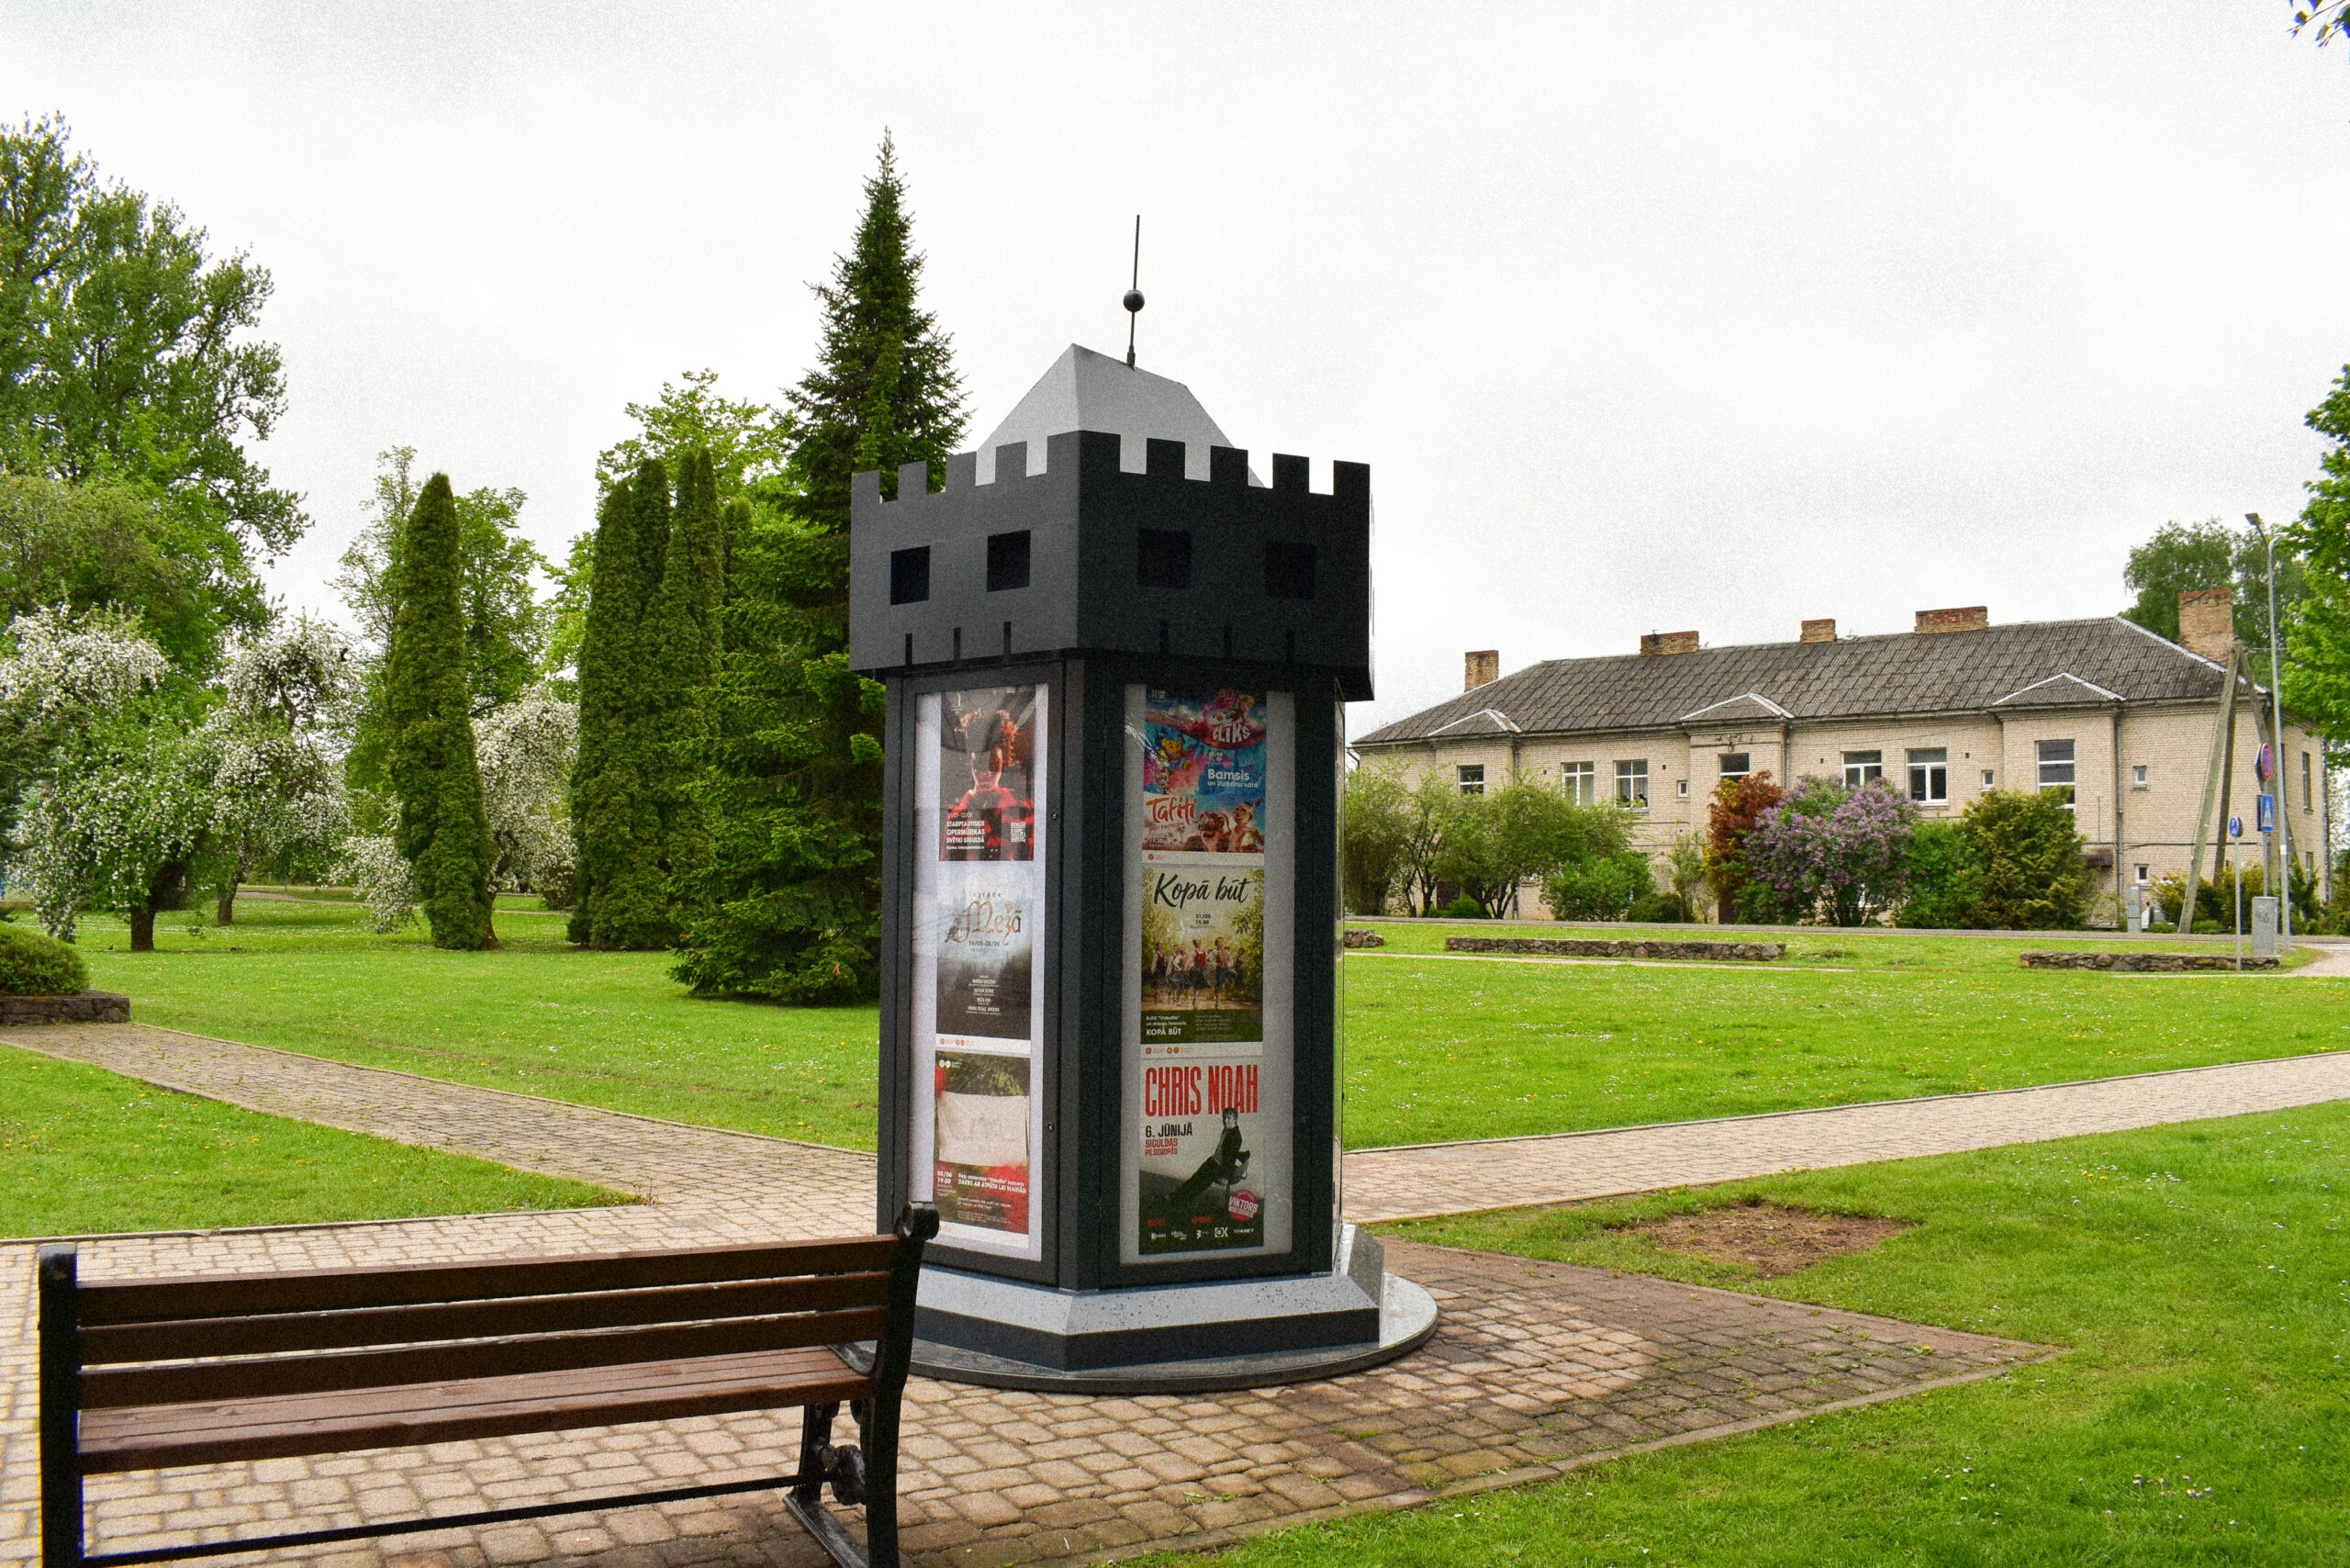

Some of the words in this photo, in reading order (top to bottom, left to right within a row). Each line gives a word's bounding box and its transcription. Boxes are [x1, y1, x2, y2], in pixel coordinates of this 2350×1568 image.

[1207, 768, 1250, 780] Bamsis
[1146, 796, 1197, 824] Tafiti
[1153, 872, 1211, 910] Kopā
[1214, 876, 1251, 903] būt
[1146, 1026, 1167, 1036] KOPĀ
[1168, 1026, 1182, 1036] BŪT
[1145, 1066, 1202, 1116] CHRIS
[1208, 1064, 1258, 1114] NOAH
[1146, 1125, 1155, 1137] 6.
[1158, 1122, 1192, 1137] JŪNIJĀ
[1145, 1137, 1178, 1148] SIGULDAS
[1228, 1195, 1259, 1213] VIKTORS
